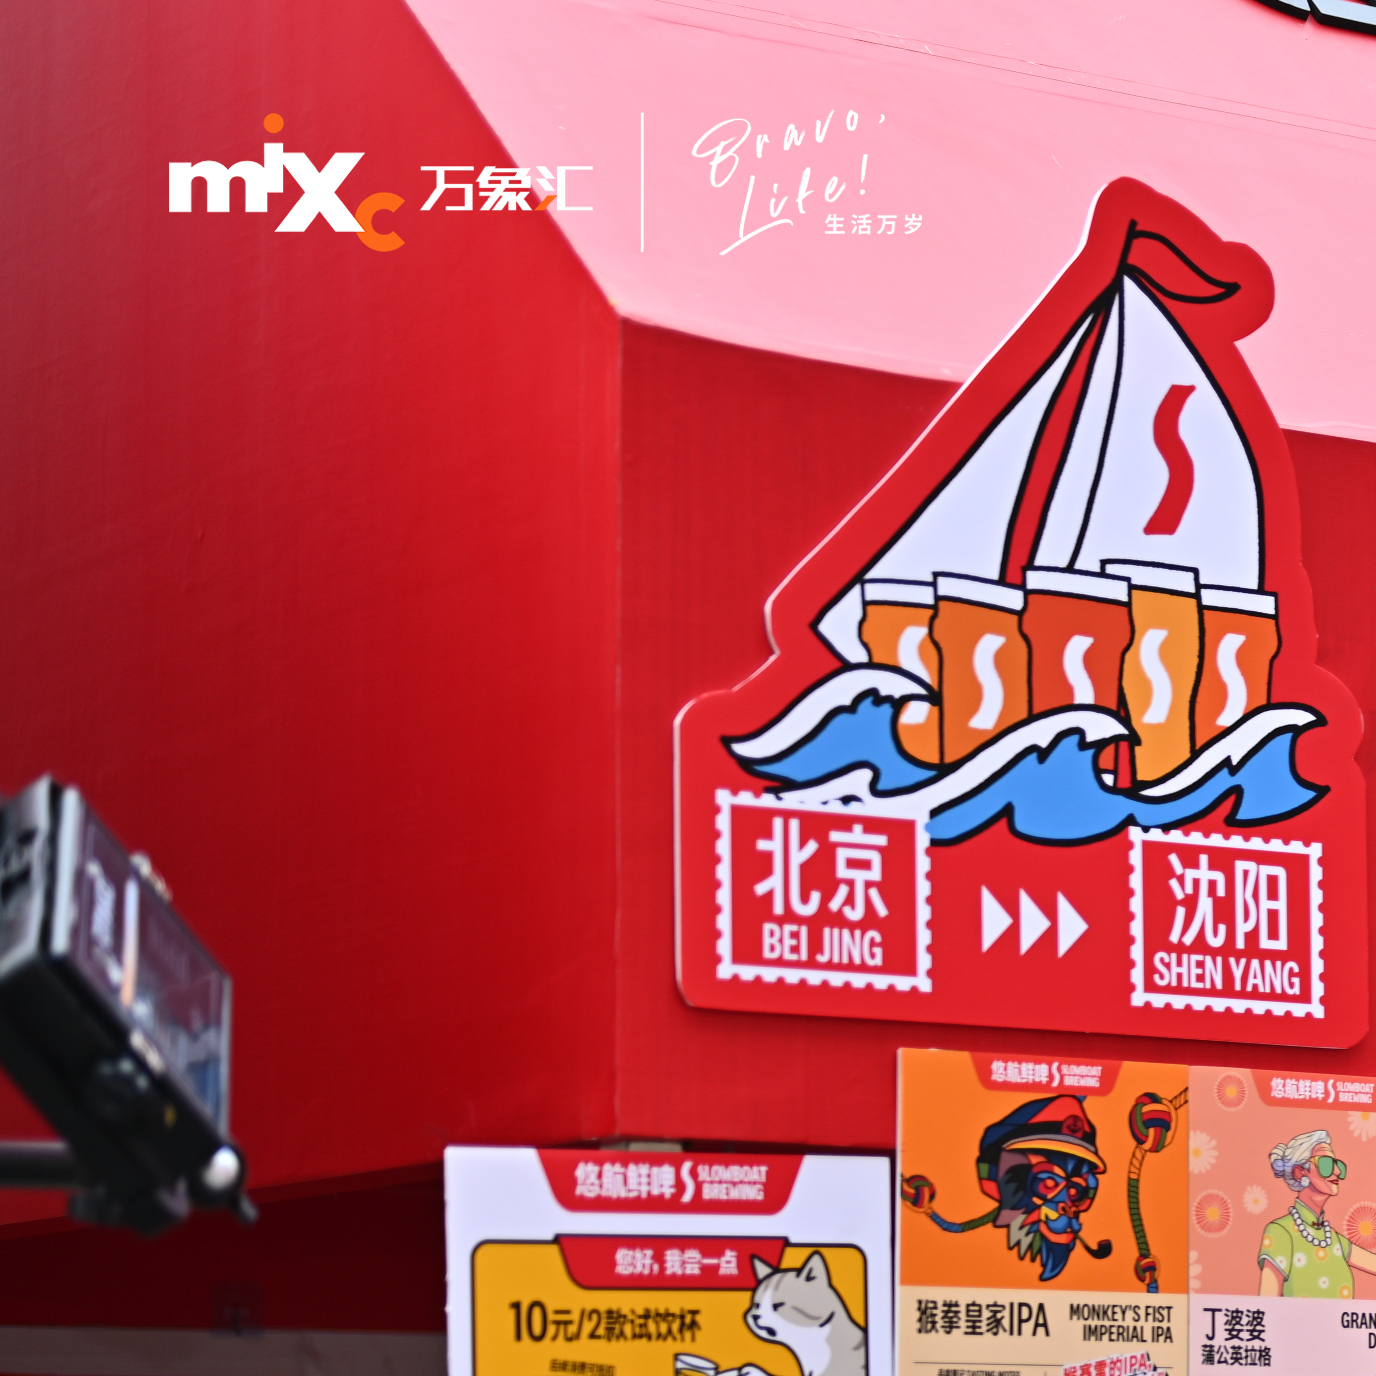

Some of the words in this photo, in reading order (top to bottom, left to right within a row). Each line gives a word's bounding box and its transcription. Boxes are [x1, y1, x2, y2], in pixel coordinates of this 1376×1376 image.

[755, 815, 888, 921] 北京
[1168, 854, 1289, 952] 沈阳
[762, 924, 811, 962] BEI
[816, 928, 883, 968] JING
[1153, 953, 1226, 992] SHEN
[1230, 958, 1301, 996] YANG
[508, 1299, 702, 1344] 10元/2款试饮杯
[916, 1299, 1051, 1337] 猴拳皇家IPA
[1083, 1324, 1147, 1343] IMPERIAL
[1151, 1326, 1174, 1343] IPA
[1144, 1306, 1173, 1323] FIST
[1203, 1308, 1266, 1342] 丁婆婆
[1201, 1345, 1272, 1367] 蒲公英拉格
